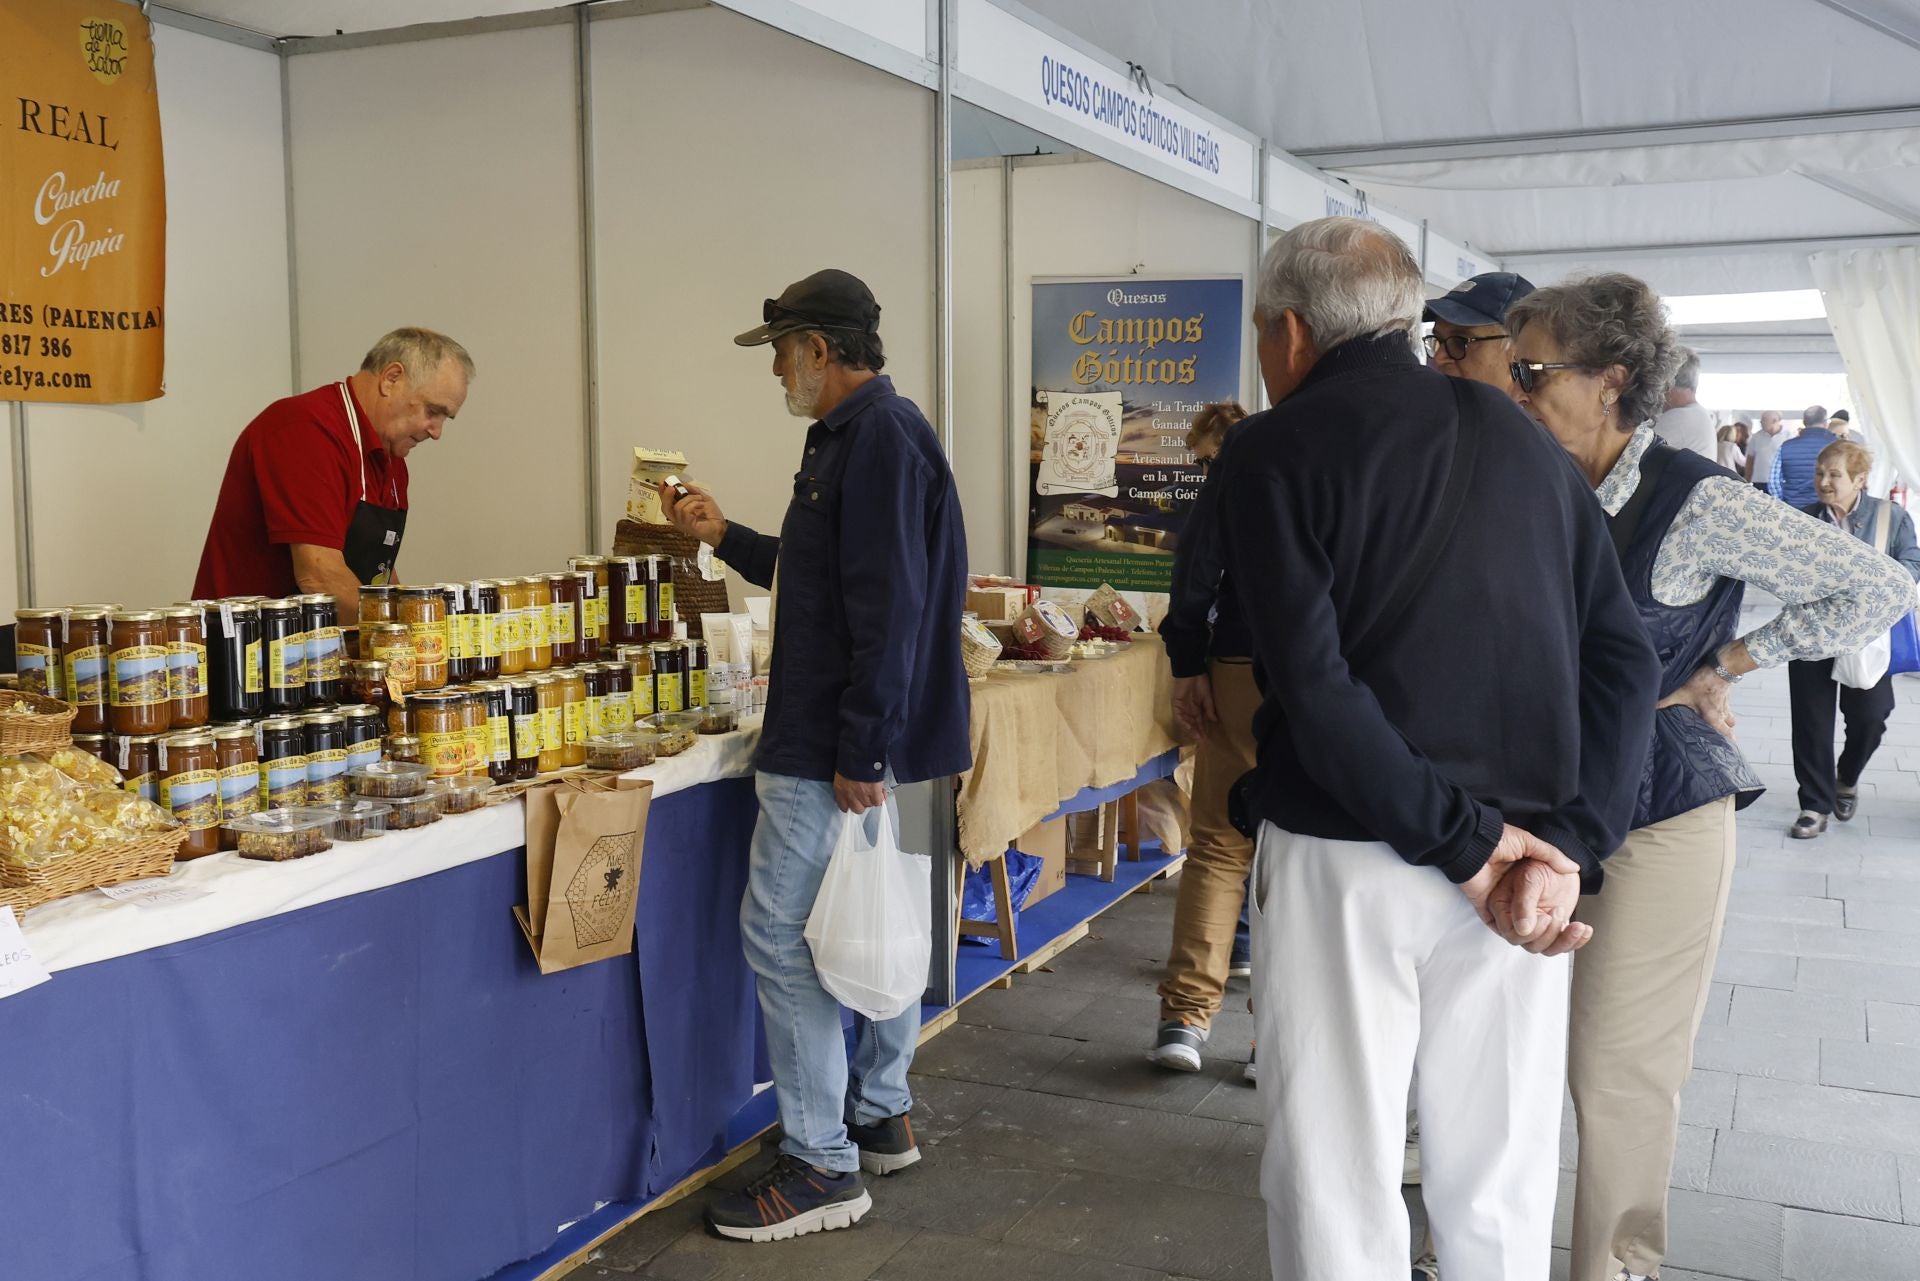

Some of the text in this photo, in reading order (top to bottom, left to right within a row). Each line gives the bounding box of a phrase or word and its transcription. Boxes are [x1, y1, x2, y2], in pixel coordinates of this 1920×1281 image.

[16, 97, 119, 151] REAL
[1042, 55, 1220, 174] QUESOS CAMPOS GÓTICOS VILLERÍAS
[34, 171, 120, 225] Cosecha
[41, 219, 124, 277] Propia
[1107, 288, 1168, 307] Quesos
[43, 304, 162, 331] (PALENCIA)
[1068, 310, 1205, 350] Campos
[2, 334, 72, 358] 817 386
[0, 365, 92, 391] elya.com
[1072, 349, 1198, 385] Góticos
[1071, 397, 1102, 410] Campos
[1174, 401, 1207, 412] Tradi
[1152, 419, 1193, 430] Ganade
[1132, 454, 1183, 465] Artesanal
[1142, 473, 1155, 482] en
[1157, 471, 1168, 482] la
[1129, 487, 1199, 502] Campos Góti
